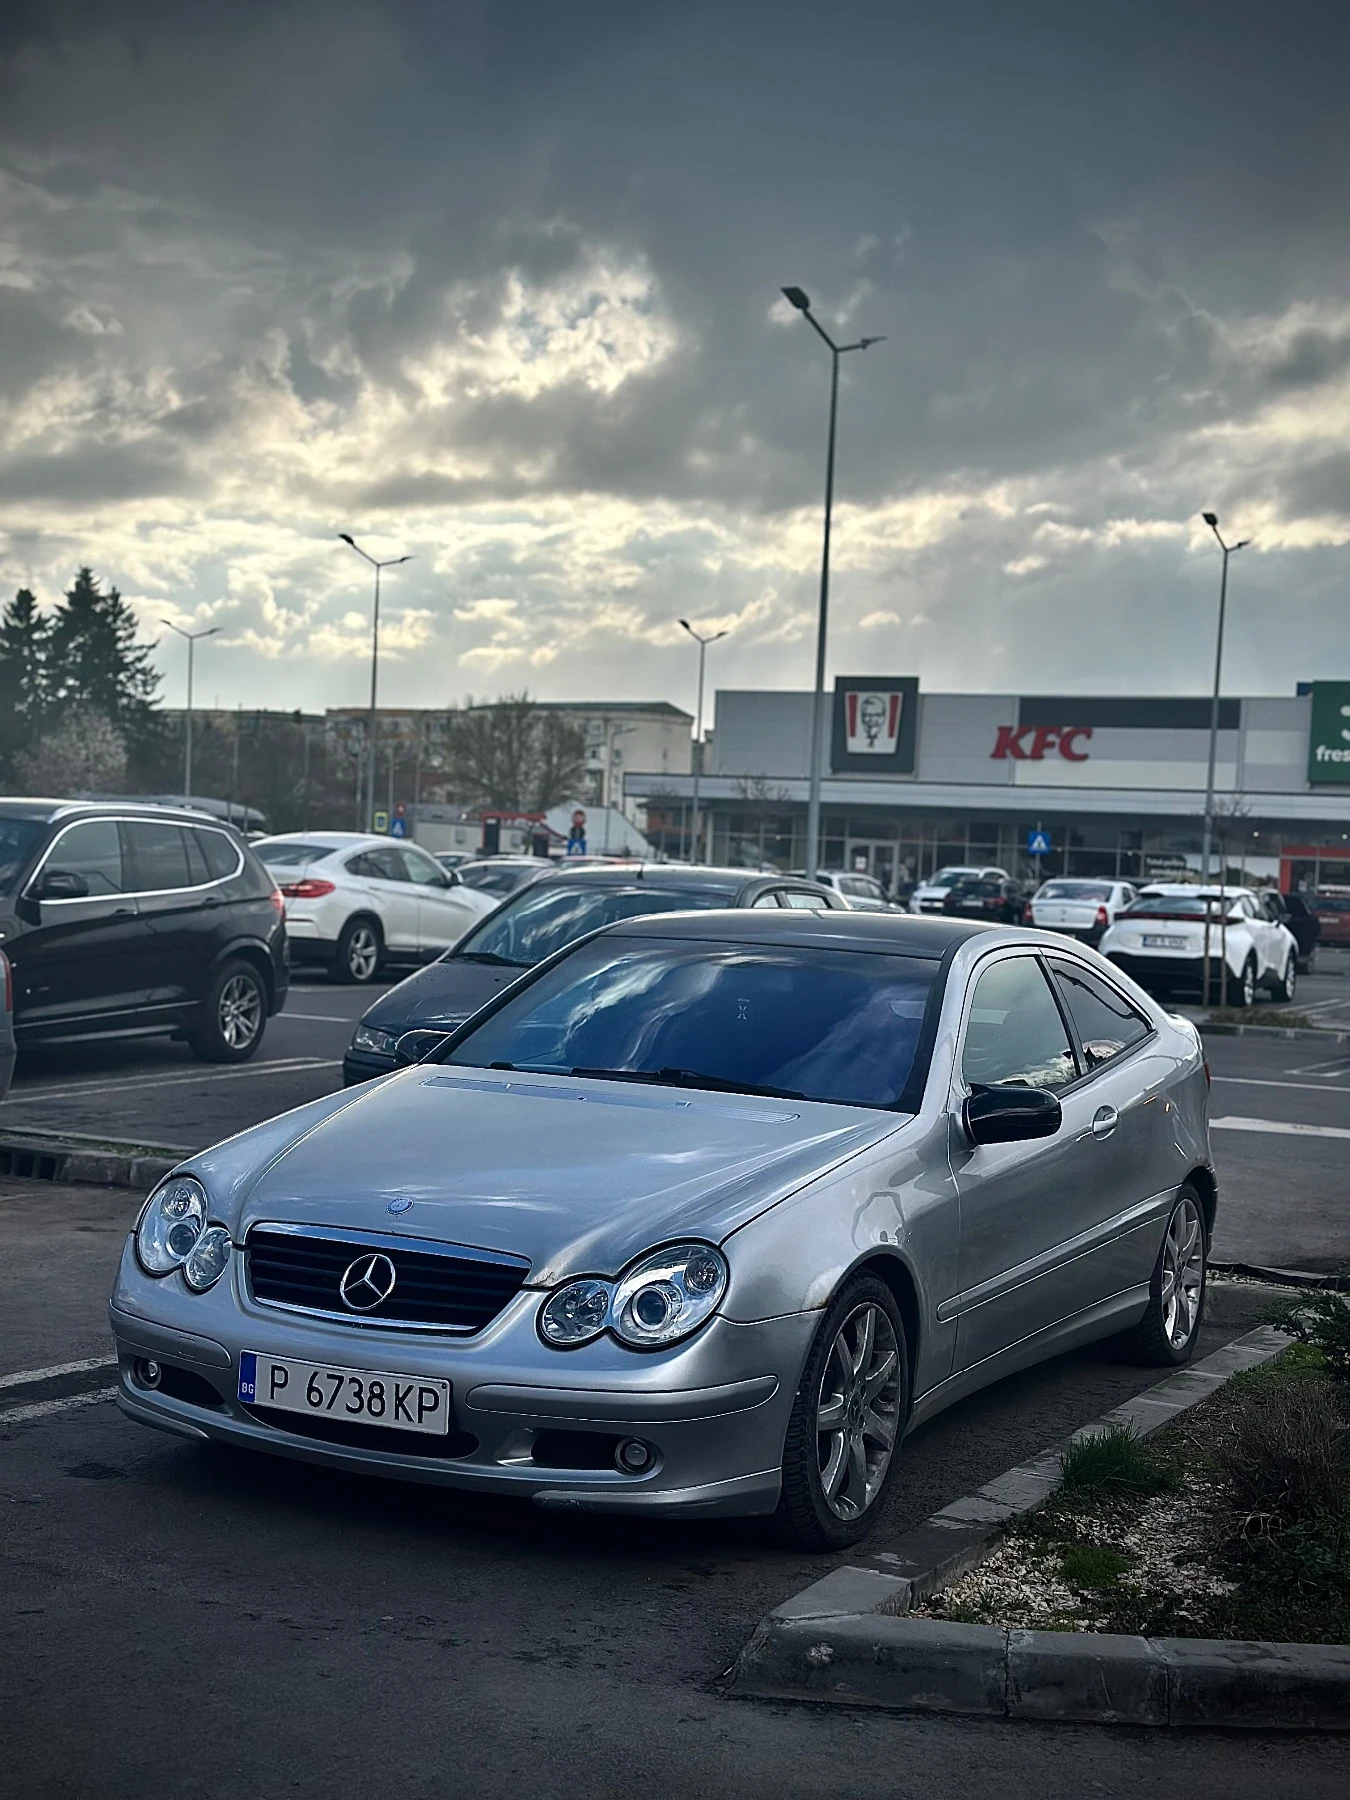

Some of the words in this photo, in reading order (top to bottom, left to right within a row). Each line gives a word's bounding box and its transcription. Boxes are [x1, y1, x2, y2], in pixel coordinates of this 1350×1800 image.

[990, 726, 1093, 761] KFC
[241, 1382, 254, 1394] BG
[270, 1364, 289, 1400] P
[306, 1371, 386, 1417] 6738
[394, 1382, 440, 1424] KP
